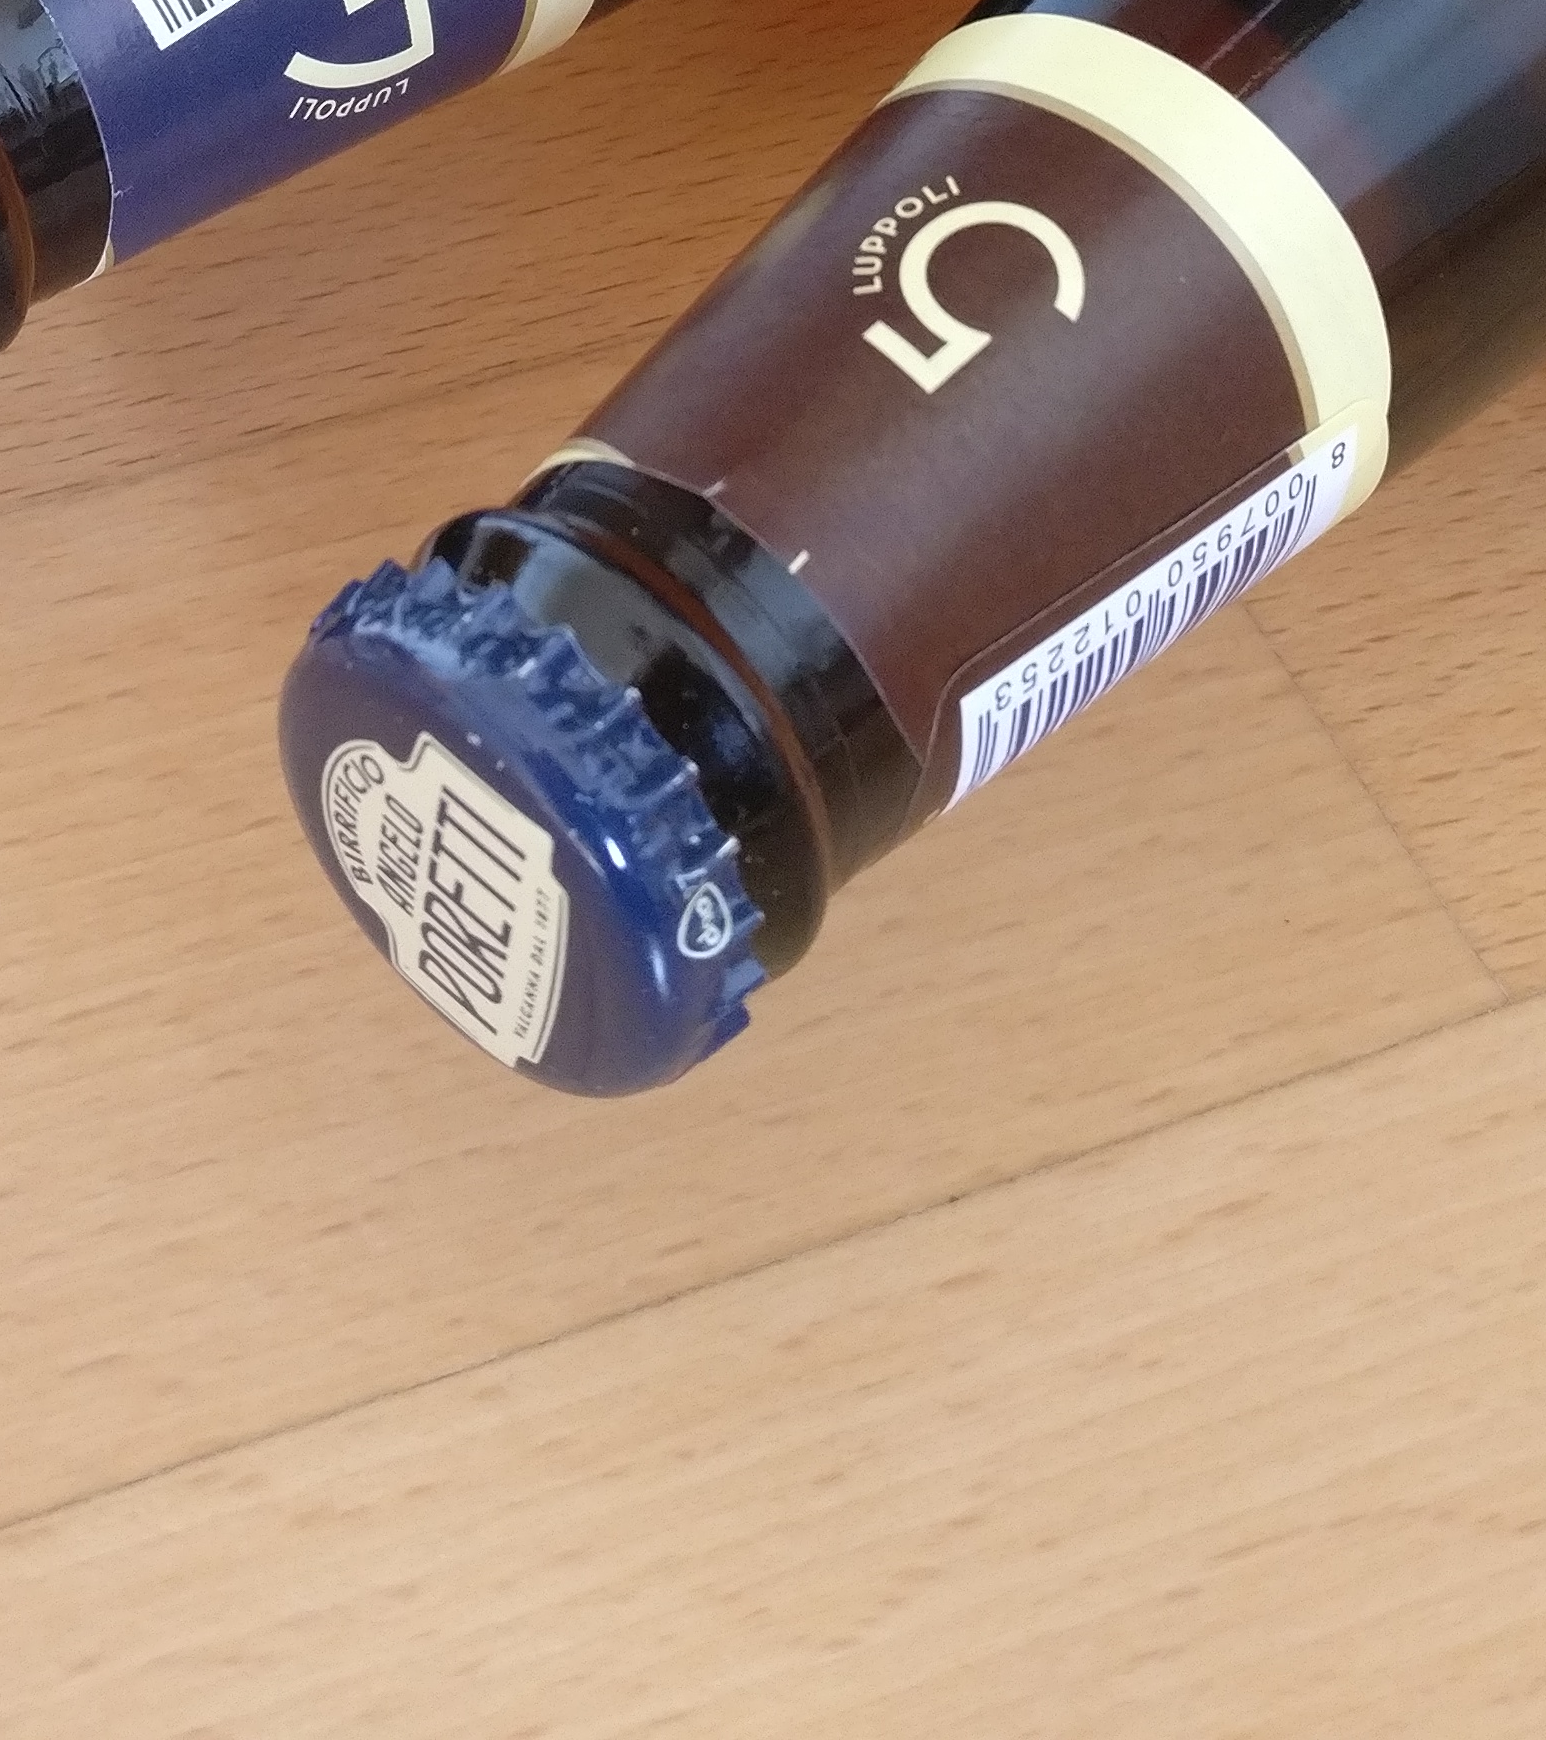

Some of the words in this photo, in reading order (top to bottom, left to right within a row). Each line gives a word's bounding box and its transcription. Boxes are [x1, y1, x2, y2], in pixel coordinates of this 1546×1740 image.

[289, 77, 411, 121] LUPPOLI
[853, 175, 961, 296] LUPPOLI
[862, 200, 1085, 395] 5
[1330, 441, 1347, 469] 8
[1167, 471, 1304, 588] 007950
[993, 589, 1143, 712] 012253
[335, 754, 384, 885] BIRRIFICIO
[376, 793, 423, 917] ANGELO
[418, 784, 526, 1036] PORETTI
